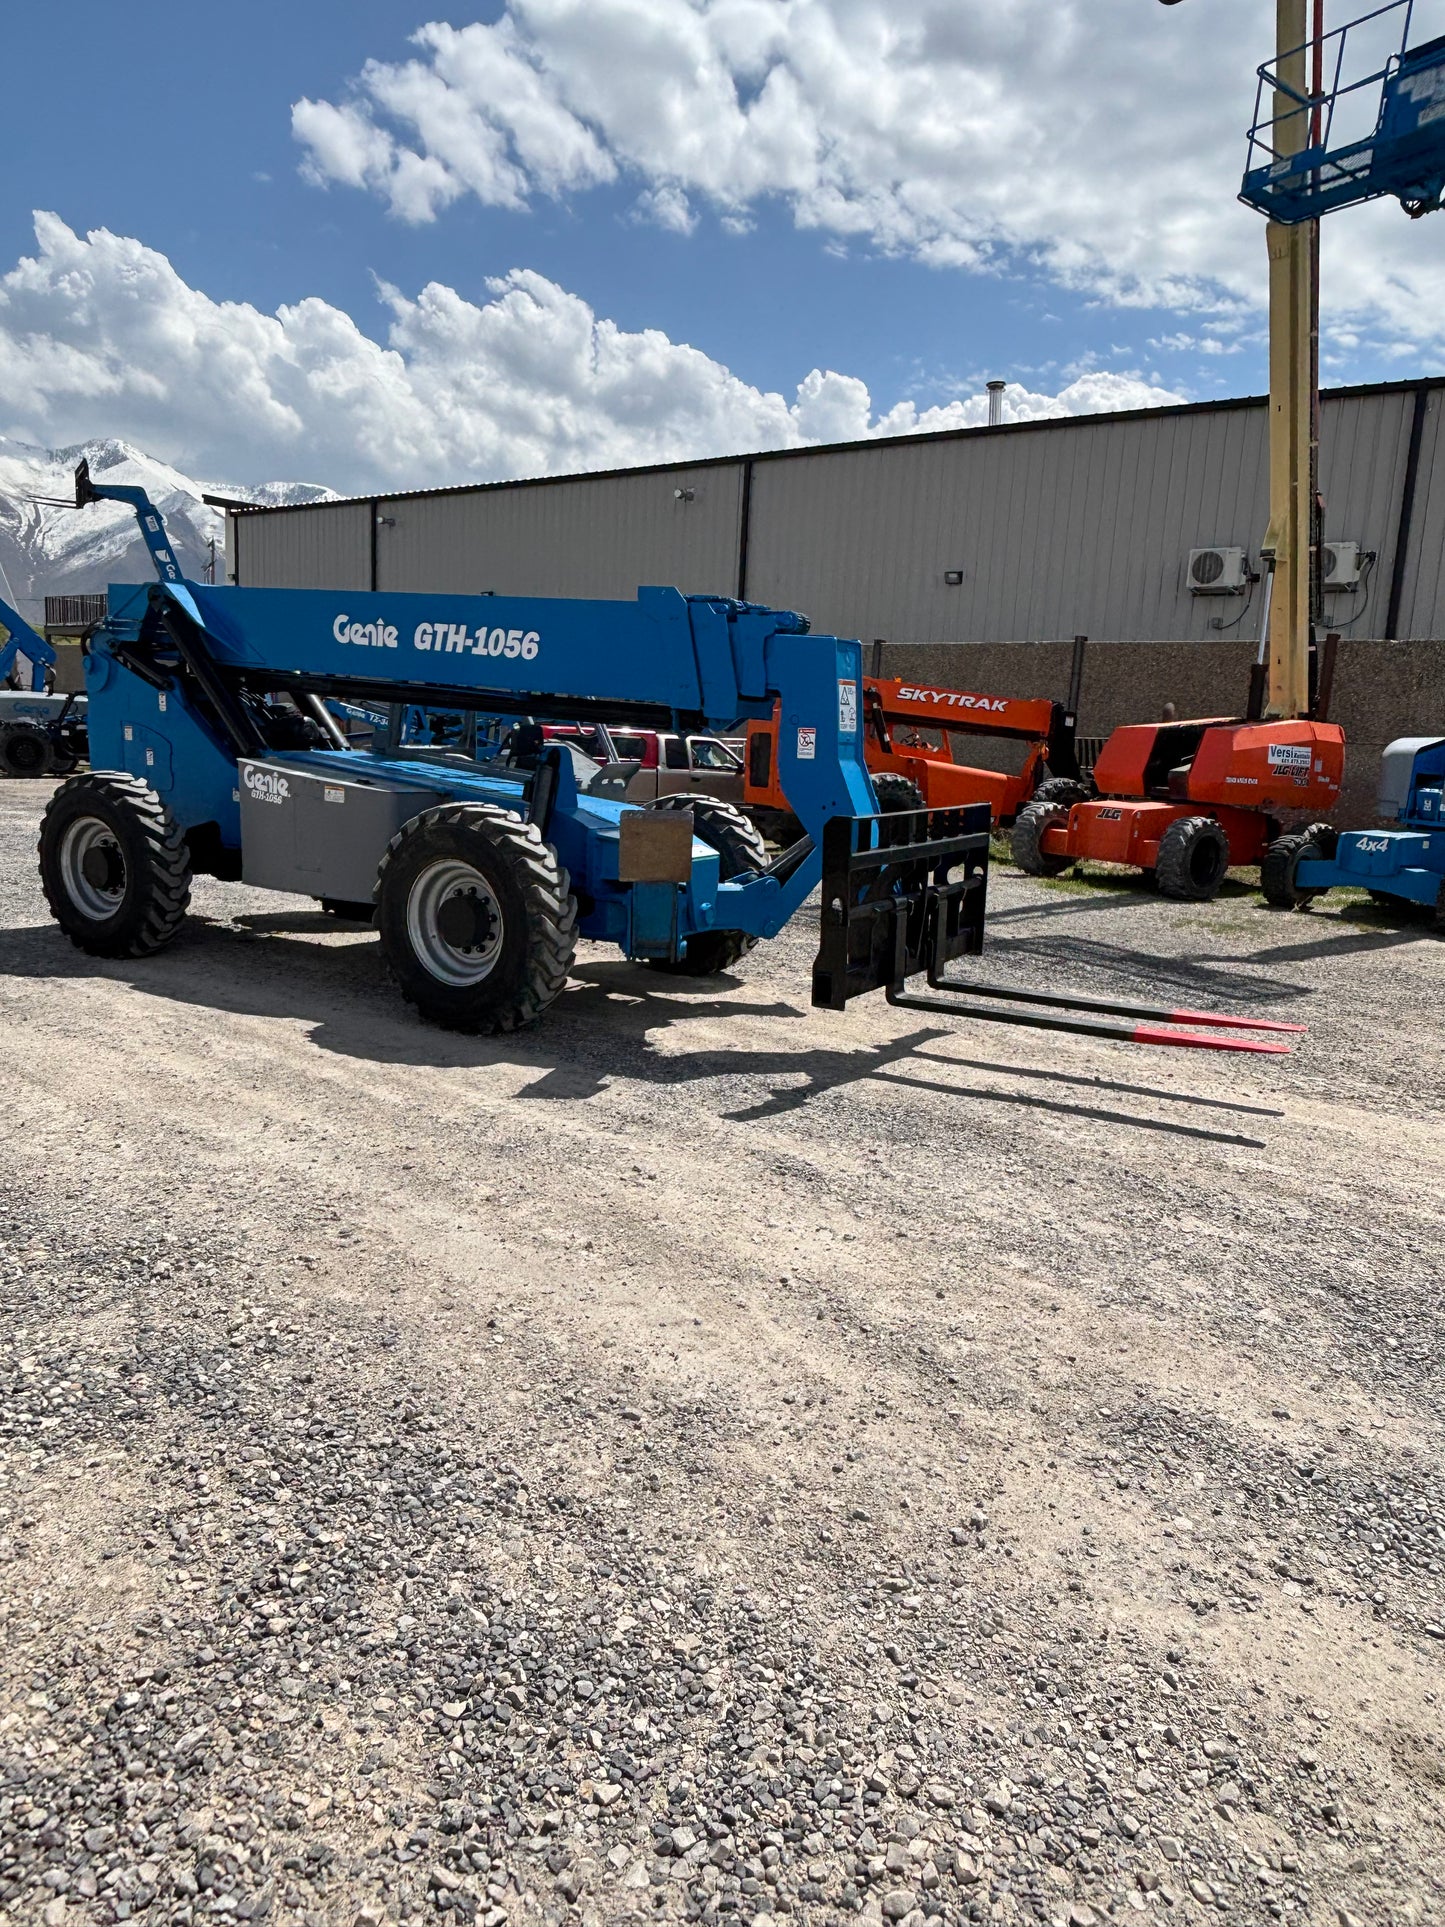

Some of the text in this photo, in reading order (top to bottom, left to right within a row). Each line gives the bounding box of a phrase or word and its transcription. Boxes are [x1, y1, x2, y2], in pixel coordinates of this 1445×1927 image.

[166, 564, 176, 580] Ge
[333, 614, 540, 660] Genie GTH-1056
[896, 687, 1009, 712] SKYTRAK
[243, 765, 289, 797] Genie
[251, 789, 283, 804] GTH-1056
[1096, 807, 1122, 820] JLG
[1356, 837, 1389, 852] 4x4
